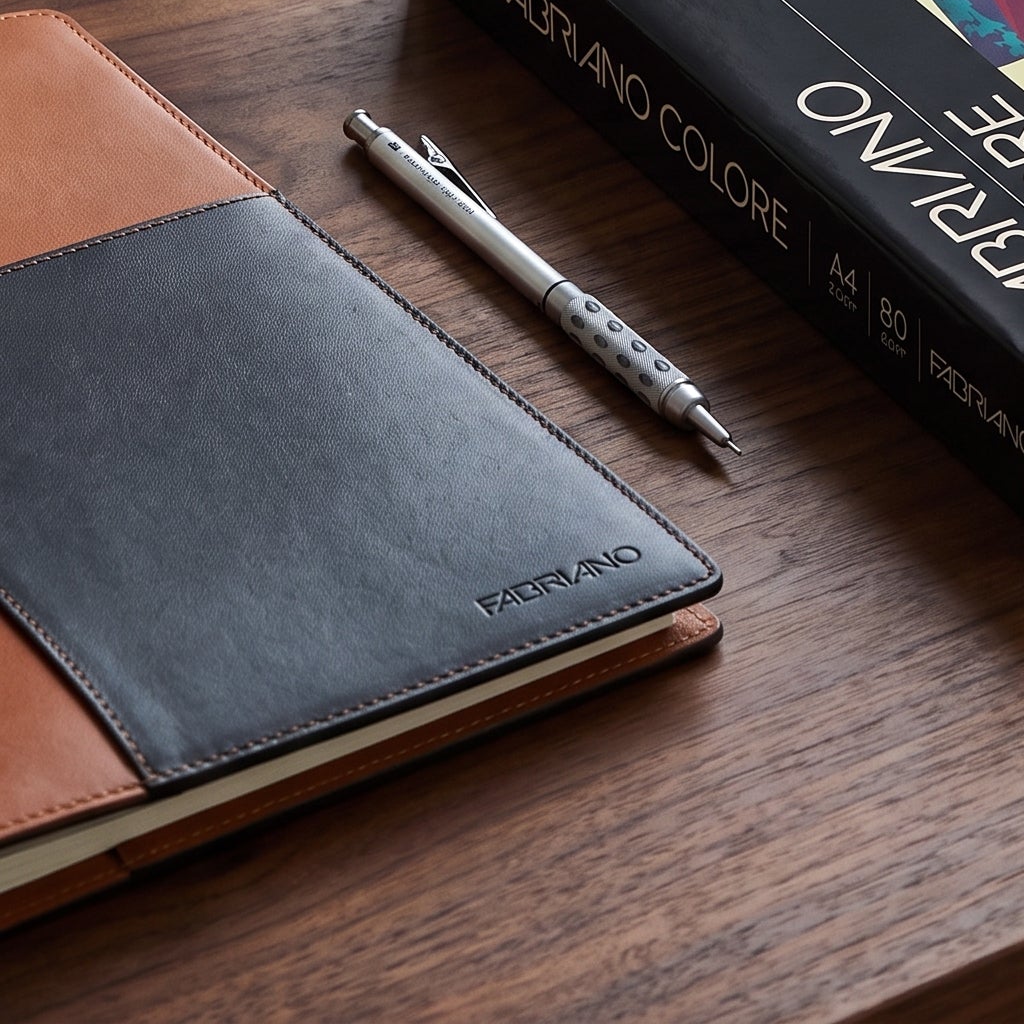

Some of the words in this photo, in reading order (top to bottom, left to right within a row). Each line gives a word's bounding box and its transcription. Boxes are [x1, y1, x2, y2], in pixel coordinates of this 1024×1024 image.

[660, 103, 789, 250] COLORE
[829, 252, 858, 296] A4
[879, 296, 907, 341] 80
[474, 544, 642, 618] FABRIANO
